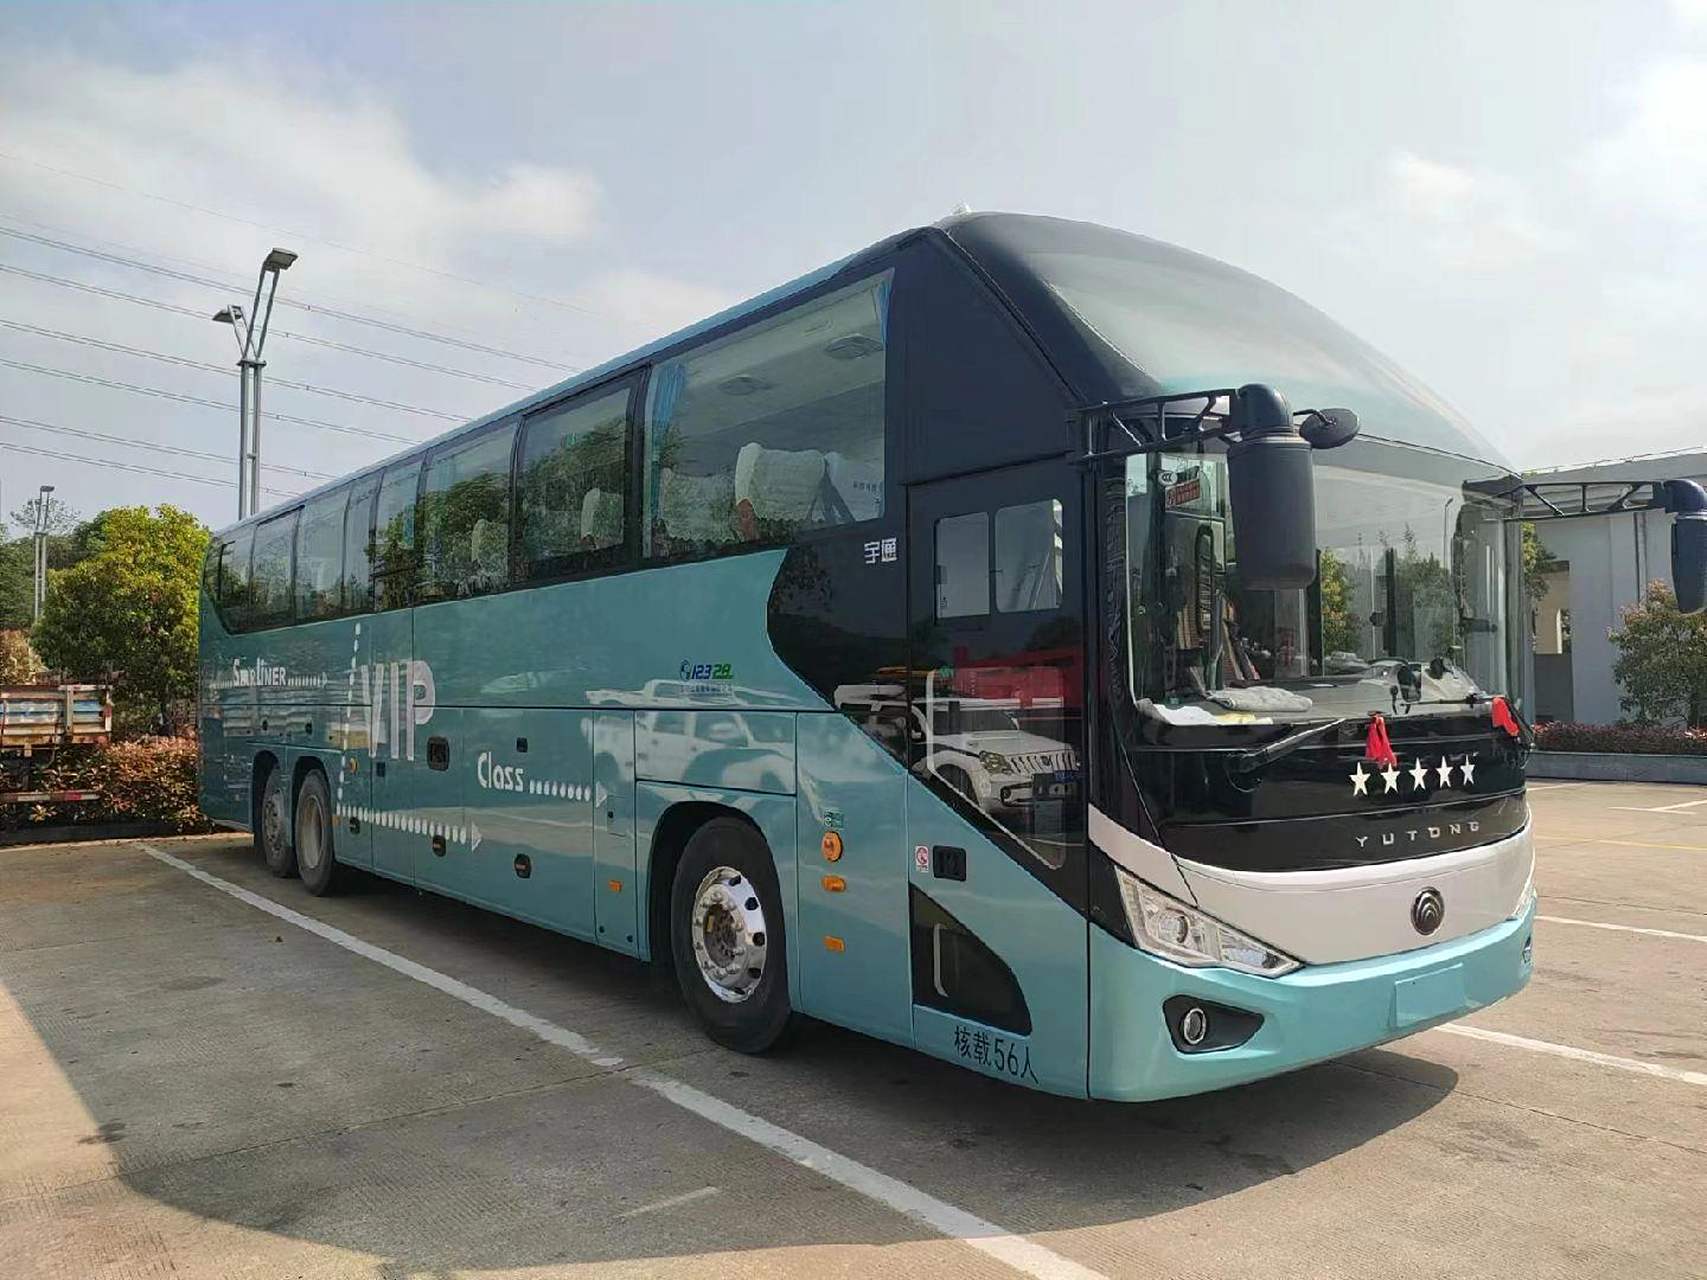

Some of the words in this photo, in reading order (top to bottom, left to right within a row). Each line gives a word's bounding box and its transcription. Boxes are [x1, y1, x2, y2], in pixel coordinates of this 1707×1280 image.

[864, 537, 897, 564] 宇通
[361, 660, 436, 761] VIP
[477, 751, 524, 792] Class
[1355, 820, 1481, 848] YUTONG
[954, 1025, 1039, 1084] 核载56人
